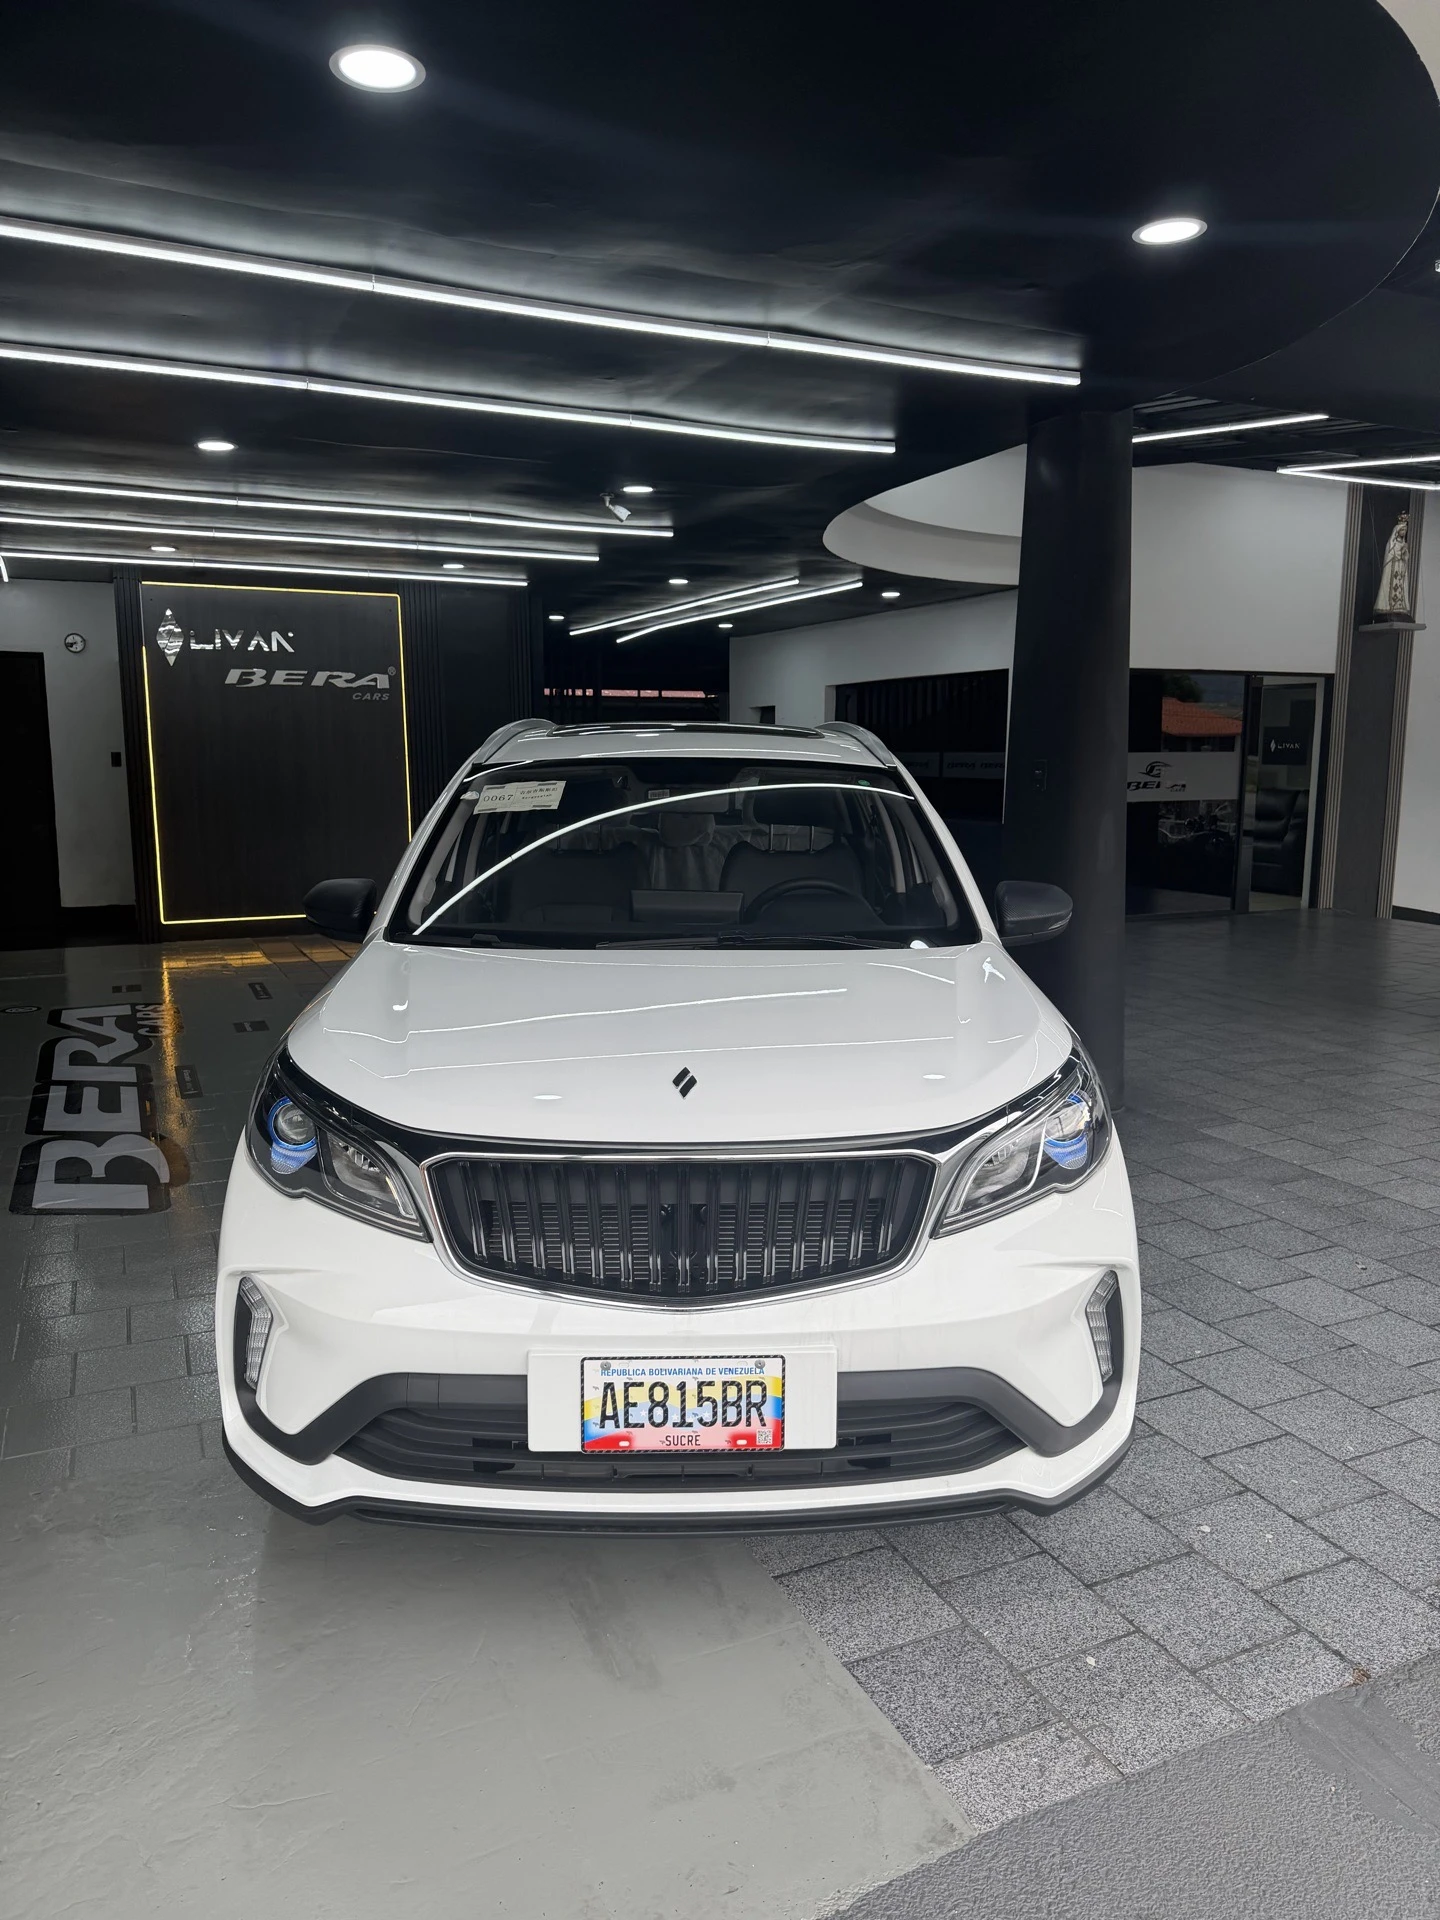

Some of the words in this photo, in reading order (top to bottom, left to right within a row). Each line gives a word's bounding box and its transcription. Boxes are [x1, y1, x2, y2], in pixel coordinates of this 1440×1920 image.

[189, 629, 295, 652] LIVAN
[225, 668, 390, 689] BERA
[352, 692, 390, 701] CARS
[483, 794, 514, 802] 0067
[32, 1004, 170, 1209] BERA
[601, 1368, 646, 1377] REPUBLICA
[649, 1368, 703, 1376] BOLIVARIANA
[719, 1367, 765, 1375] VENEZUELA
[600, 1381, 767, 1428] AE815BR
[665, 1435, 701, 1446] SUCRE
